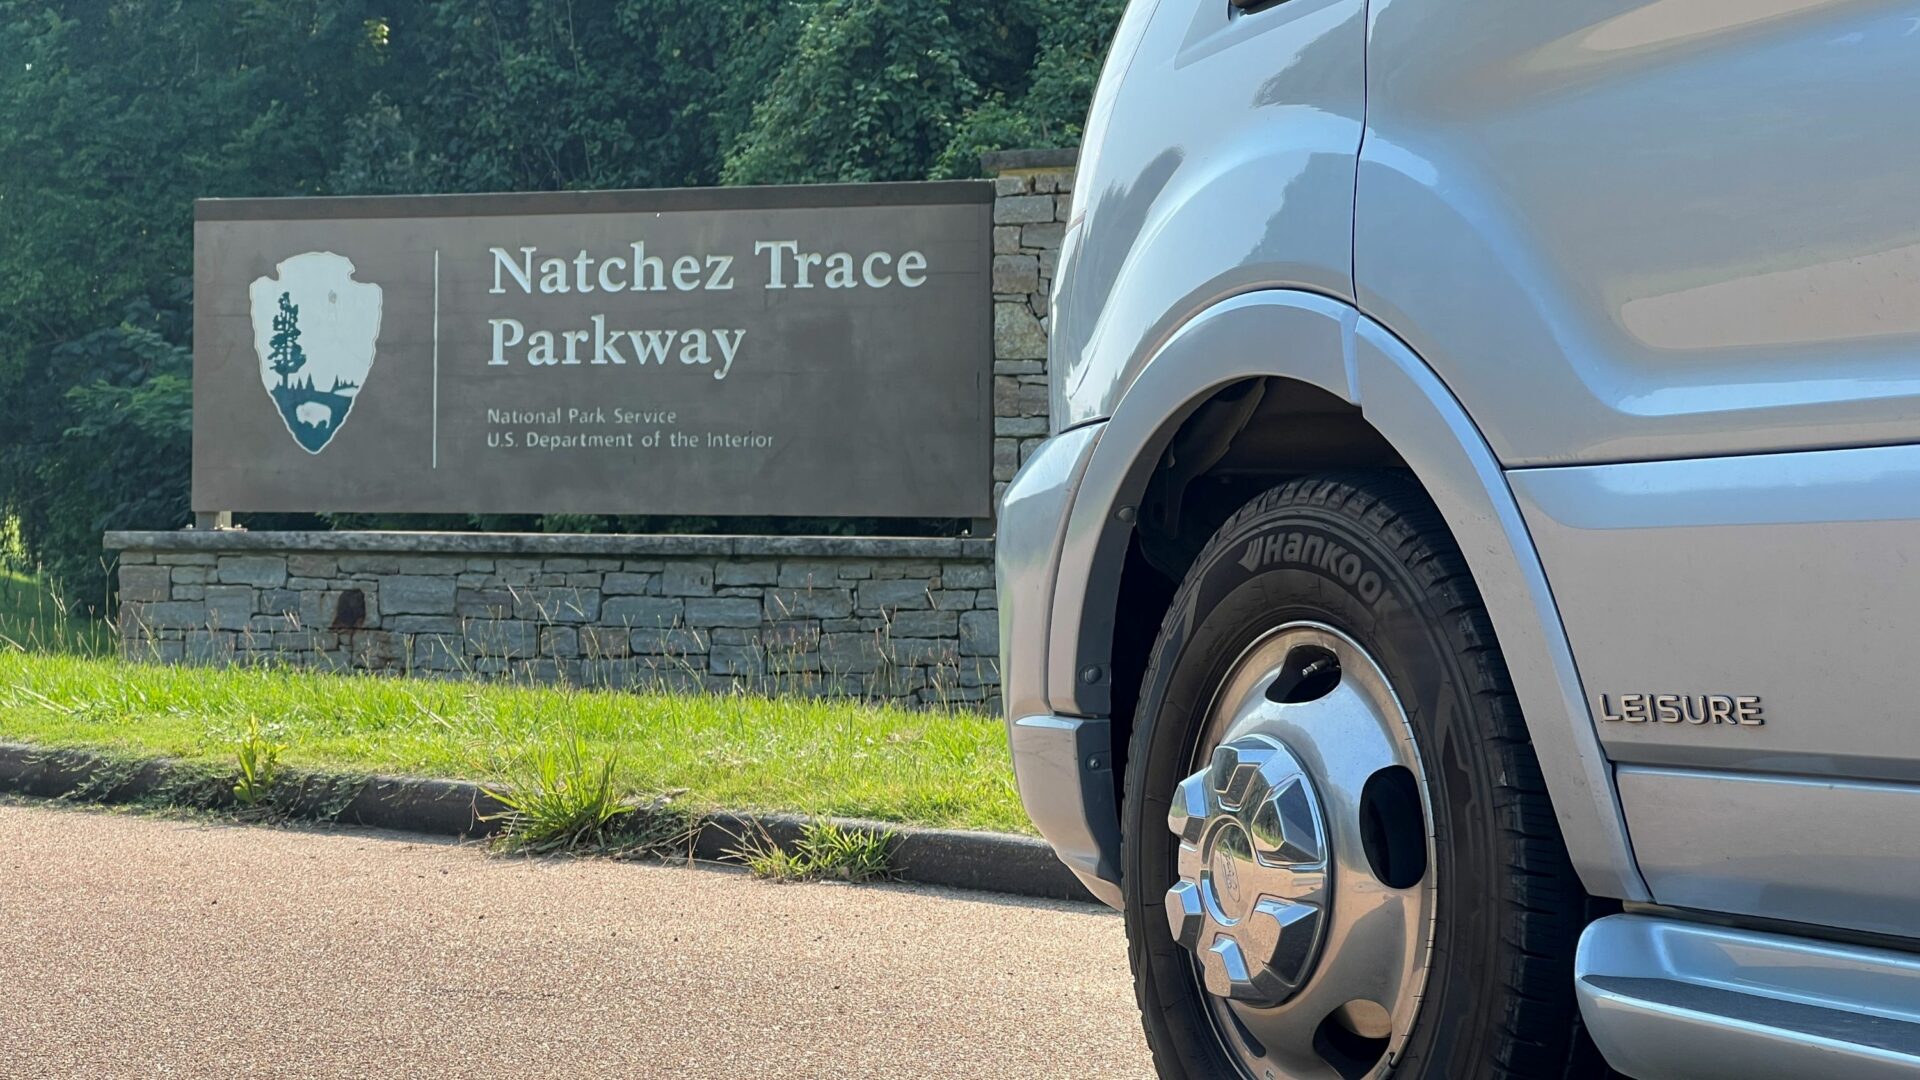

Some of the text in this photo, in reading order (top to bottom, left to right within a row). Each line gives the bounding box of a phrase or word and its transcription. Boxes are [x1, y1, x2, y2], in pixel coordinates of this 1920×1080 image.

[488, 239, 928, 294] Natchez Trace
[487, 313, 747, 380] Parkway
[487, 407, 677, 424] National Park Service
[487, 430, 773, 451] U.S. Department of the Interior
[1599, 693, 1764, 726] LEISURE
